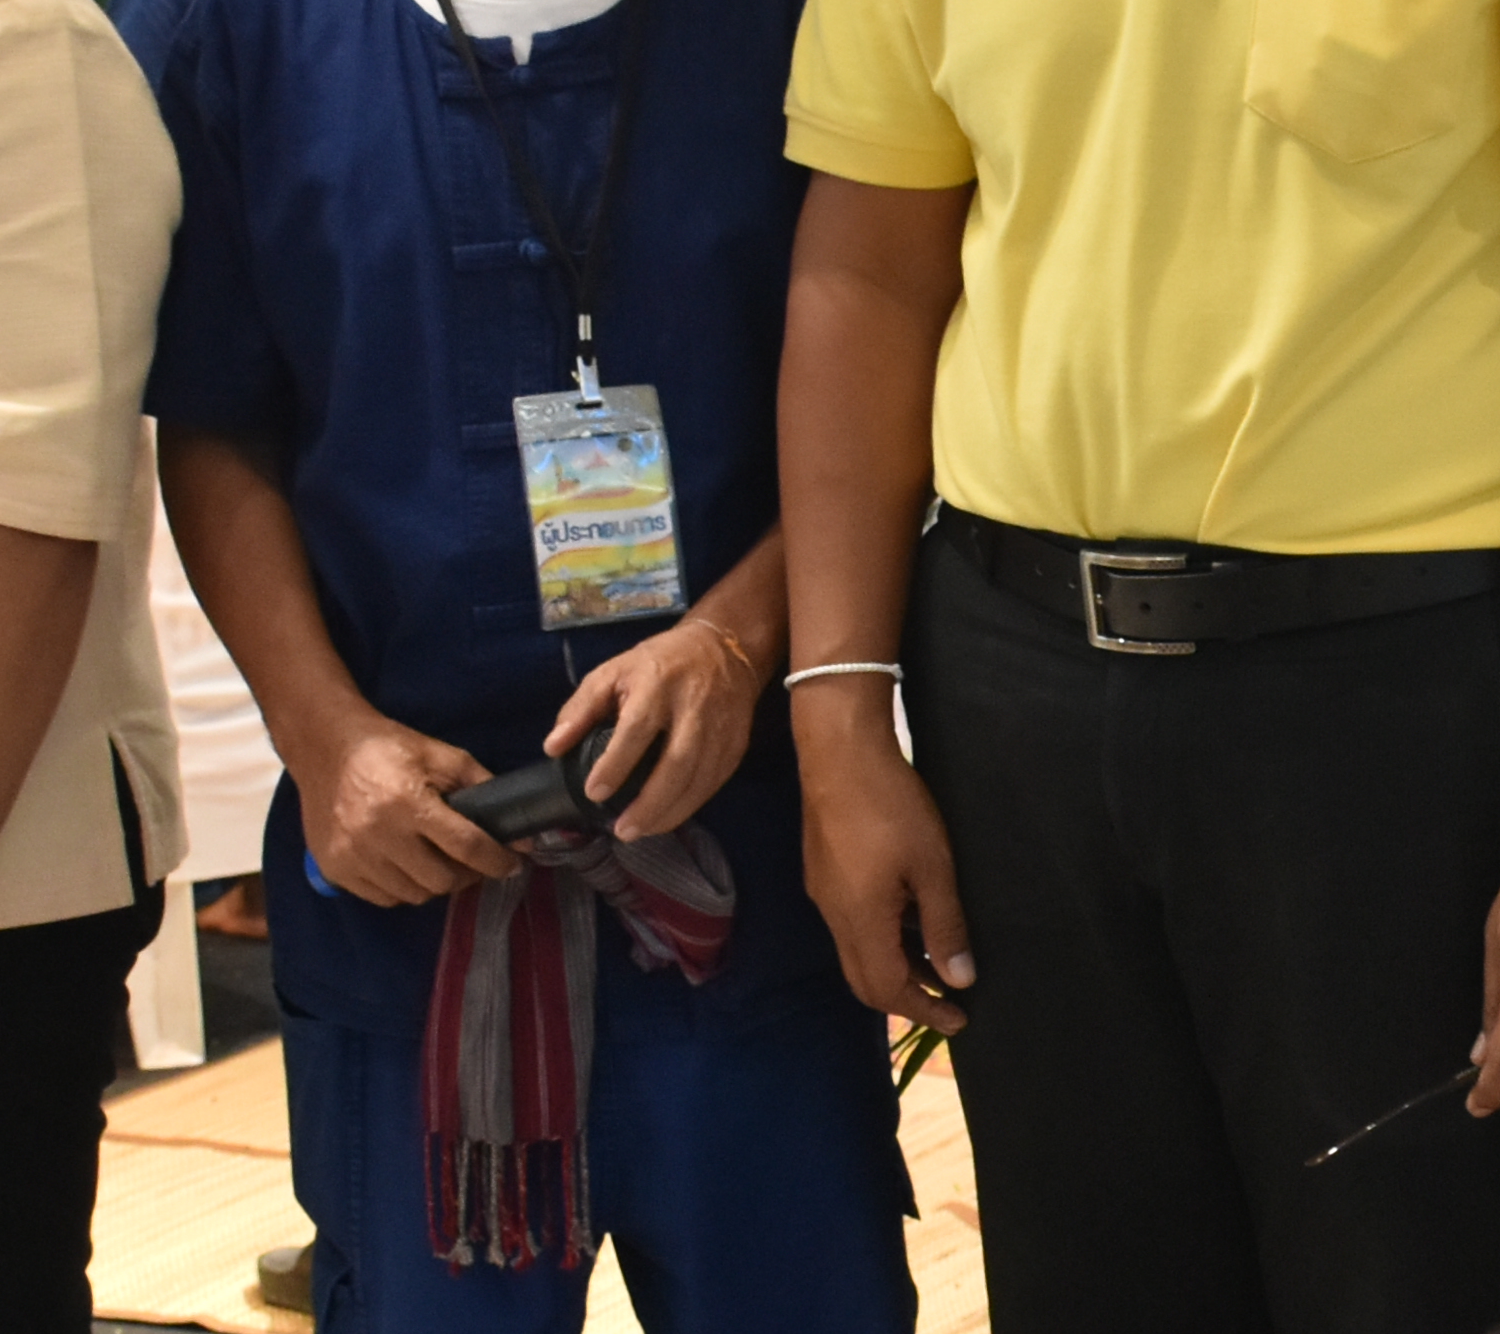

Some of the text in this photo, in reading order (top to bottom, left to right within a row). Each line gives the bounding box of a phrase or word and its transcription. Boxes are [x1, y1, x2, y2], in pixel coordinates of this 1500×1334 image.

[540, 515, 667, 552] ผู้ประกอบการ
